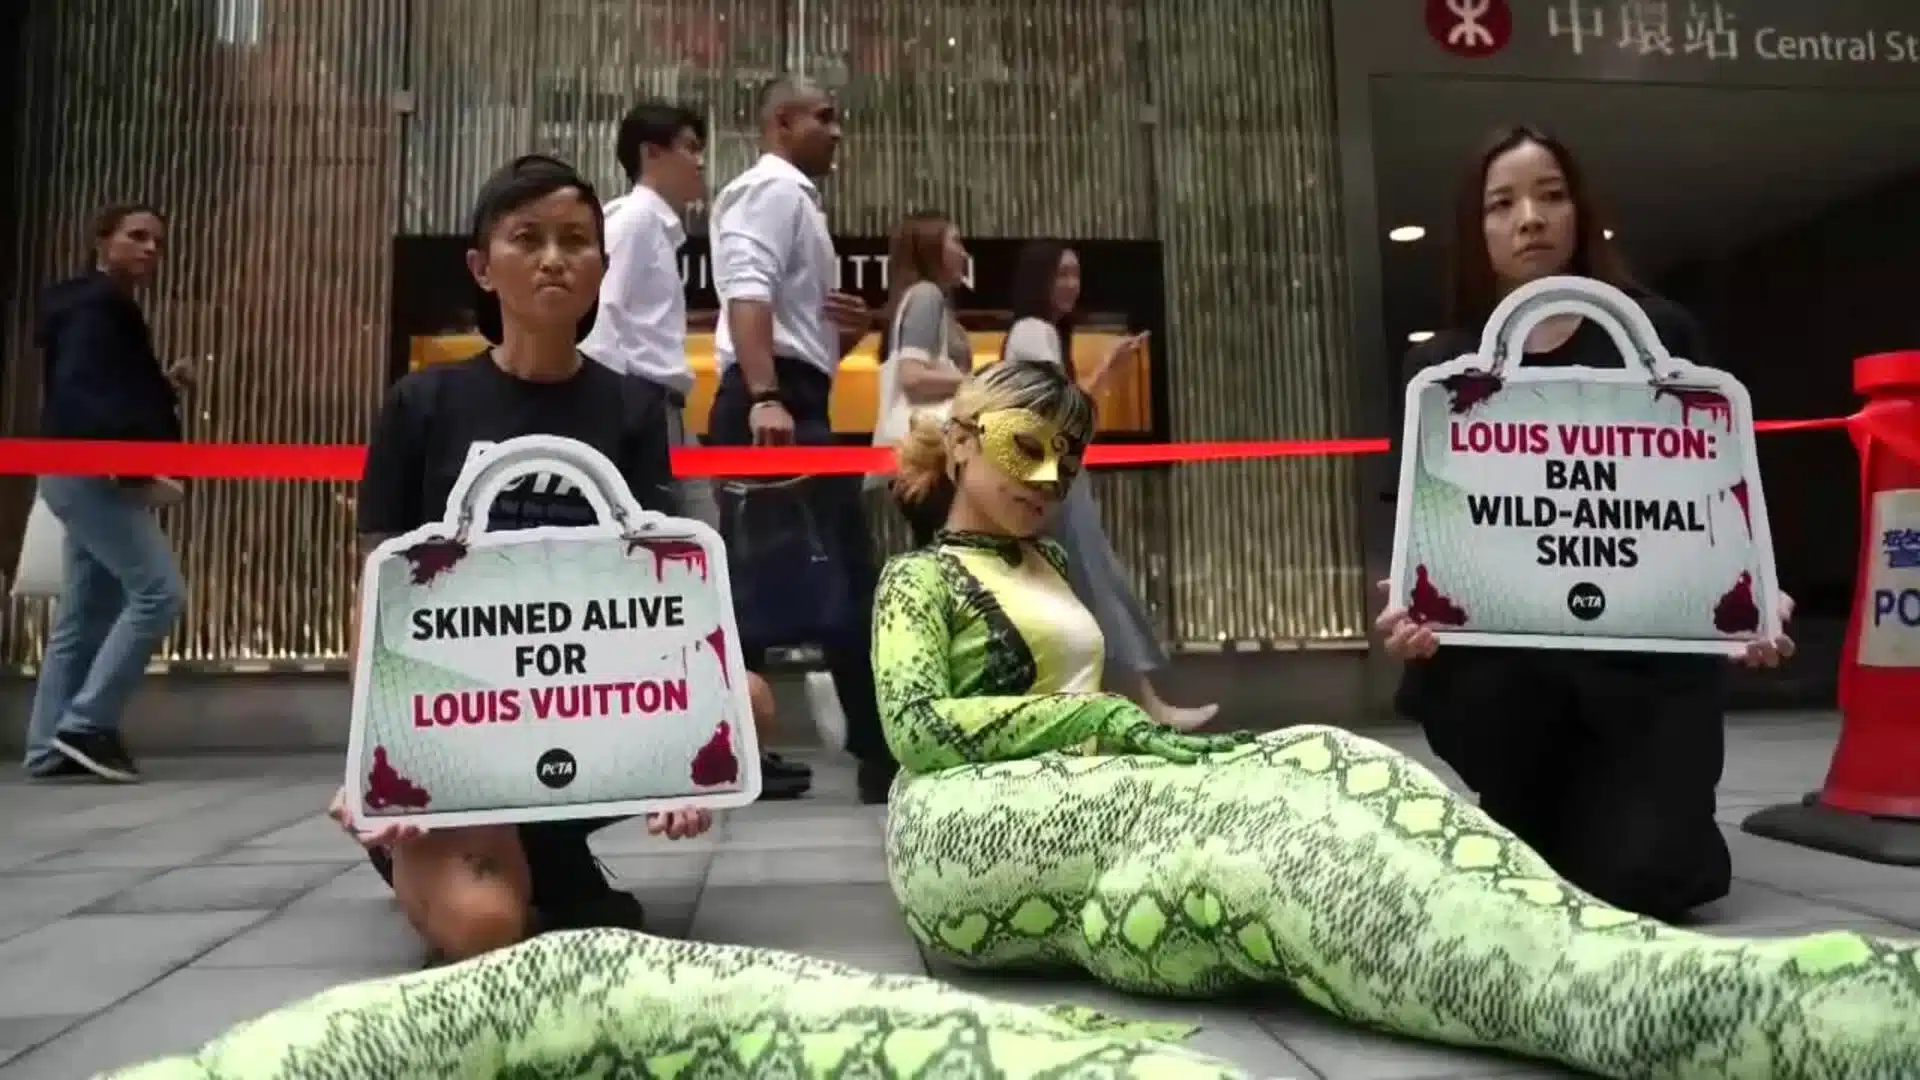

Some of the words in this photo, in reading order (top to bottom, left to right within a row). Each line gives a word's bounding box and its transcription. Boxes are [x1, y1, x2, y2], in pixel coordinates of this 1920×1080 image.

[1549, 0, 1738, 59] 中環站
[1755, 27, 1876, 60] Central
[1451, 422, 1550, 455] LOUIS
[1558, 425, 1717, 459] VUITTON:
[1546, 460, 1616, 491] BAN
[1468, 495, 1705, 531] WILD-ANIMAL
[1537, 535, 1638, 567] SKINS
[412, 601, 572, 640] SKINNED
[582, 595, 684, 631] ALIVE
[515, 643, 586, 677] FOR
[413, 688, 521, 728] LOUIS
[532, 679, 687, 720] VUITTON
